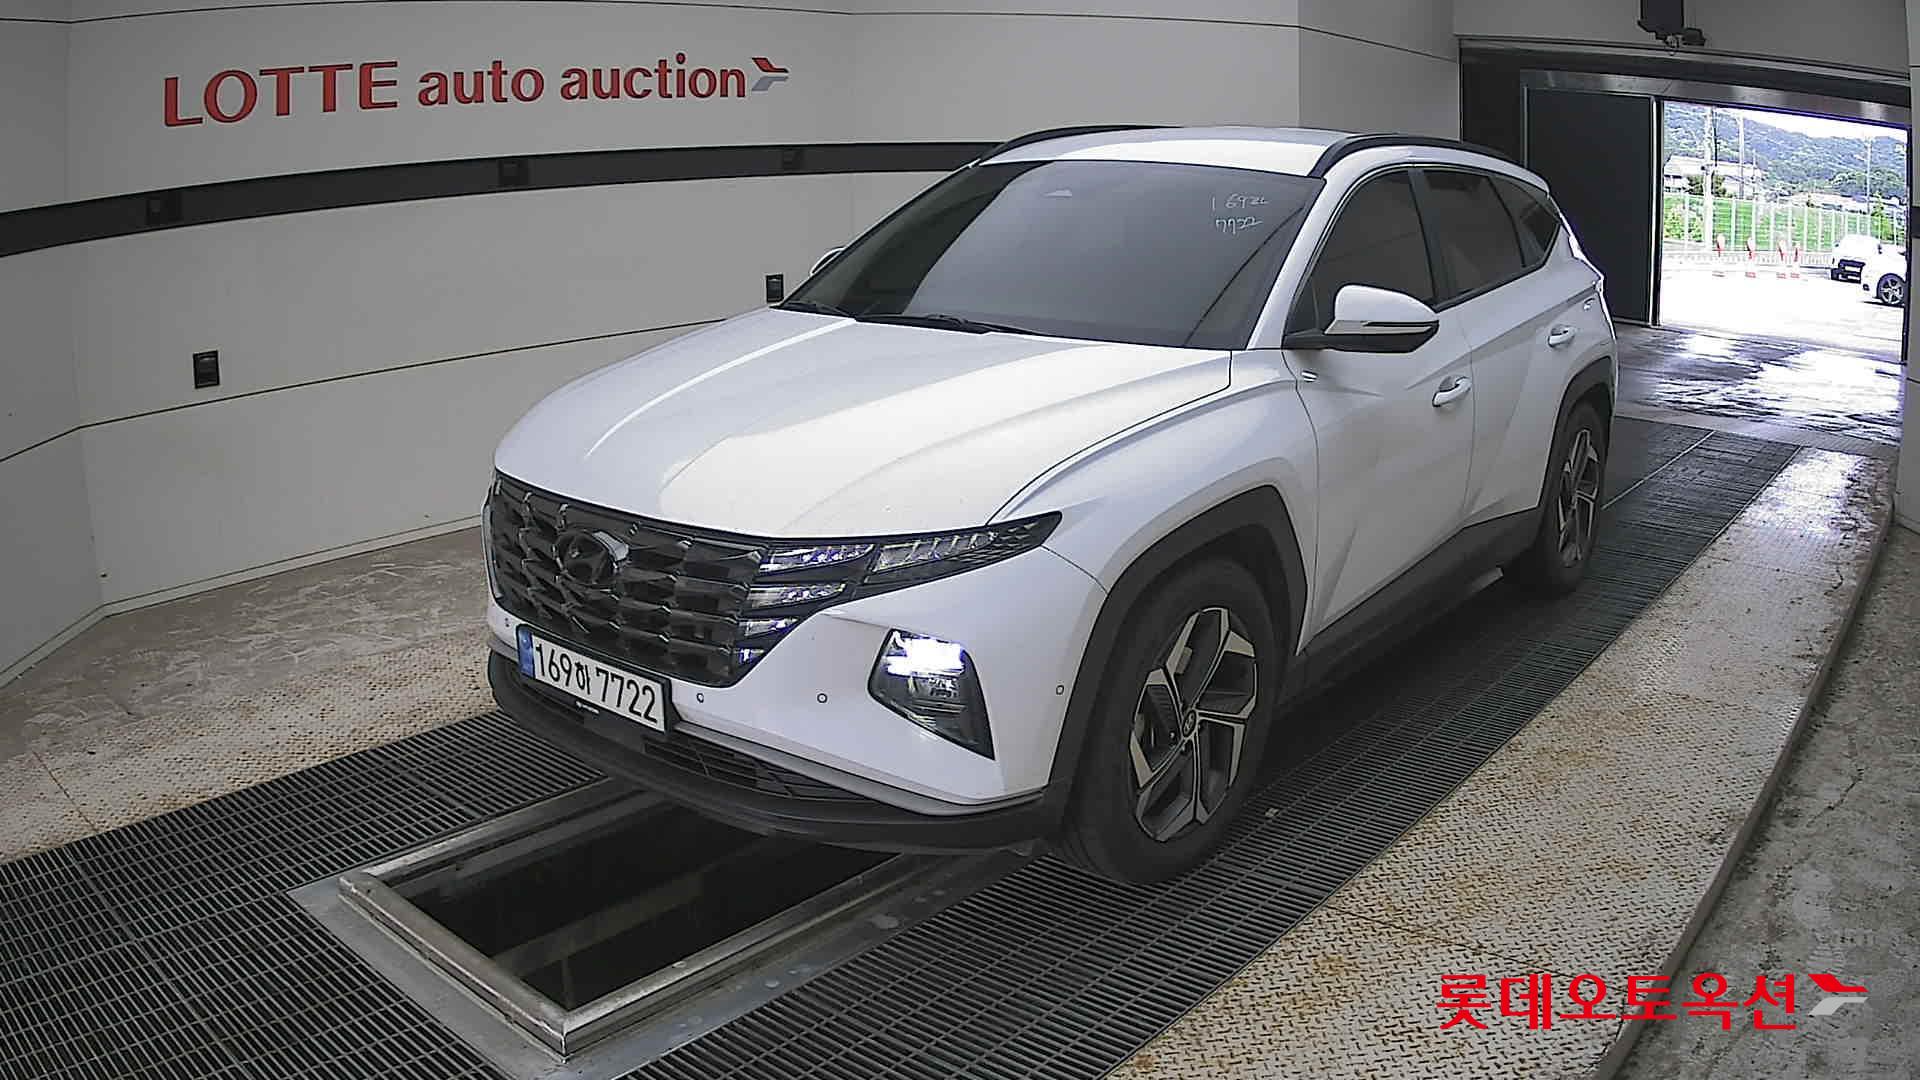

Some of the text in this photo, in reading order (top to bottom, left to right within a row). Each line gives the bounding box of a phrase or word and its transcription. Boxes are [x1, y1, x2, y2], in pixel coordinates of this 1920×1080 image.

[164, 52, 747, 127] LOTTE auto auction
